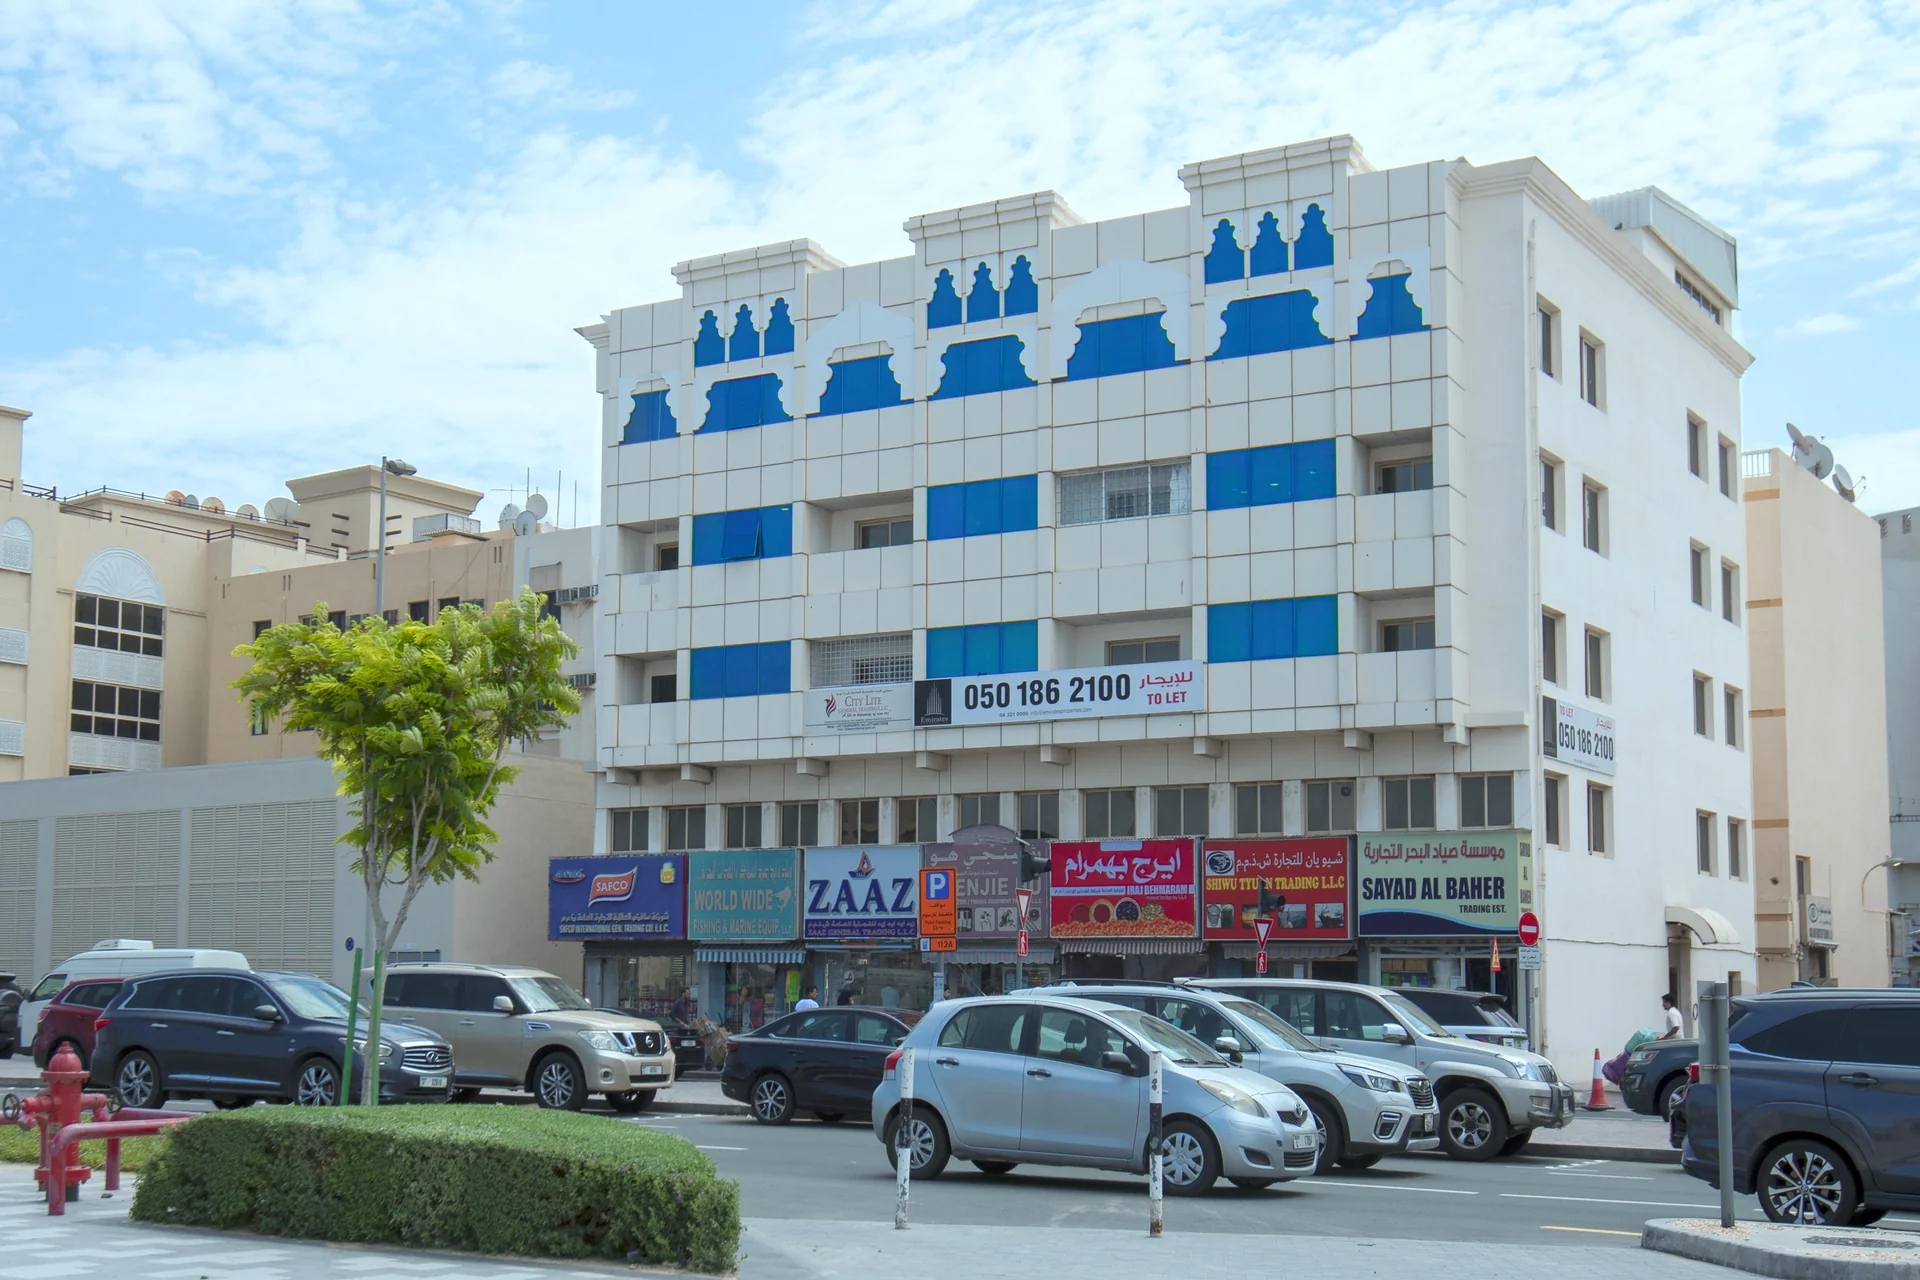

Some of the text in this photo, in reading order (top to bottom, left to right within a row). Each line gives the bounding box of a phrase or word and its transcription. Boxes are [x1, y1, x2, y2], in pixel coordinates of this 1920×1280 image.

[964, 673, 1131, 710] 050 186 2100
[1147, 691, 1187, 705] TO LET
[1559, 722, 1576, 750] 050
[1577, 728, 1592, 755] 186
[1594, 733, 1614, 761] 2100
[1274, 851, 1303, 868] للتجارة
[1306, 852, 1320, 868] يان
[1322, 851, 1344, 868] شيو
[1364, 842, 1402, 864] التجارية
[1405, 843, 1430, 864] البحر
[1432, 842, 1458, 864] صياد
[1064, 847, 1181, 885] ايرج بهمرام
[596, 880, 628, 892] SAFCO
[930, 873, 946, 898] P
[958, 878, 1008, 896] ENJIE
[1127, 884, 1188, 895] IRAJ BEHMARAM
[1206, 876, 1344, 890] SHIWU TYUN TRADING L.L.C
[1362, 876, 1504, 900] SAYAD AL BAHER
[694, 889, 773, 911] WORLD WIDE
[808, 878, 914, 915] ZAAZ
[1459, 904, 1506, 913] TRADING EST.
[693, 919, 720, 934] FISHING
[722, 919, 727, 934] &
[730, 919, 756, 934] MARINE
[808, 928, 827, 936] ZAAZ
[828, 928, 861, 936] GENERAL
[862, 928, 896, 936] TRADING
